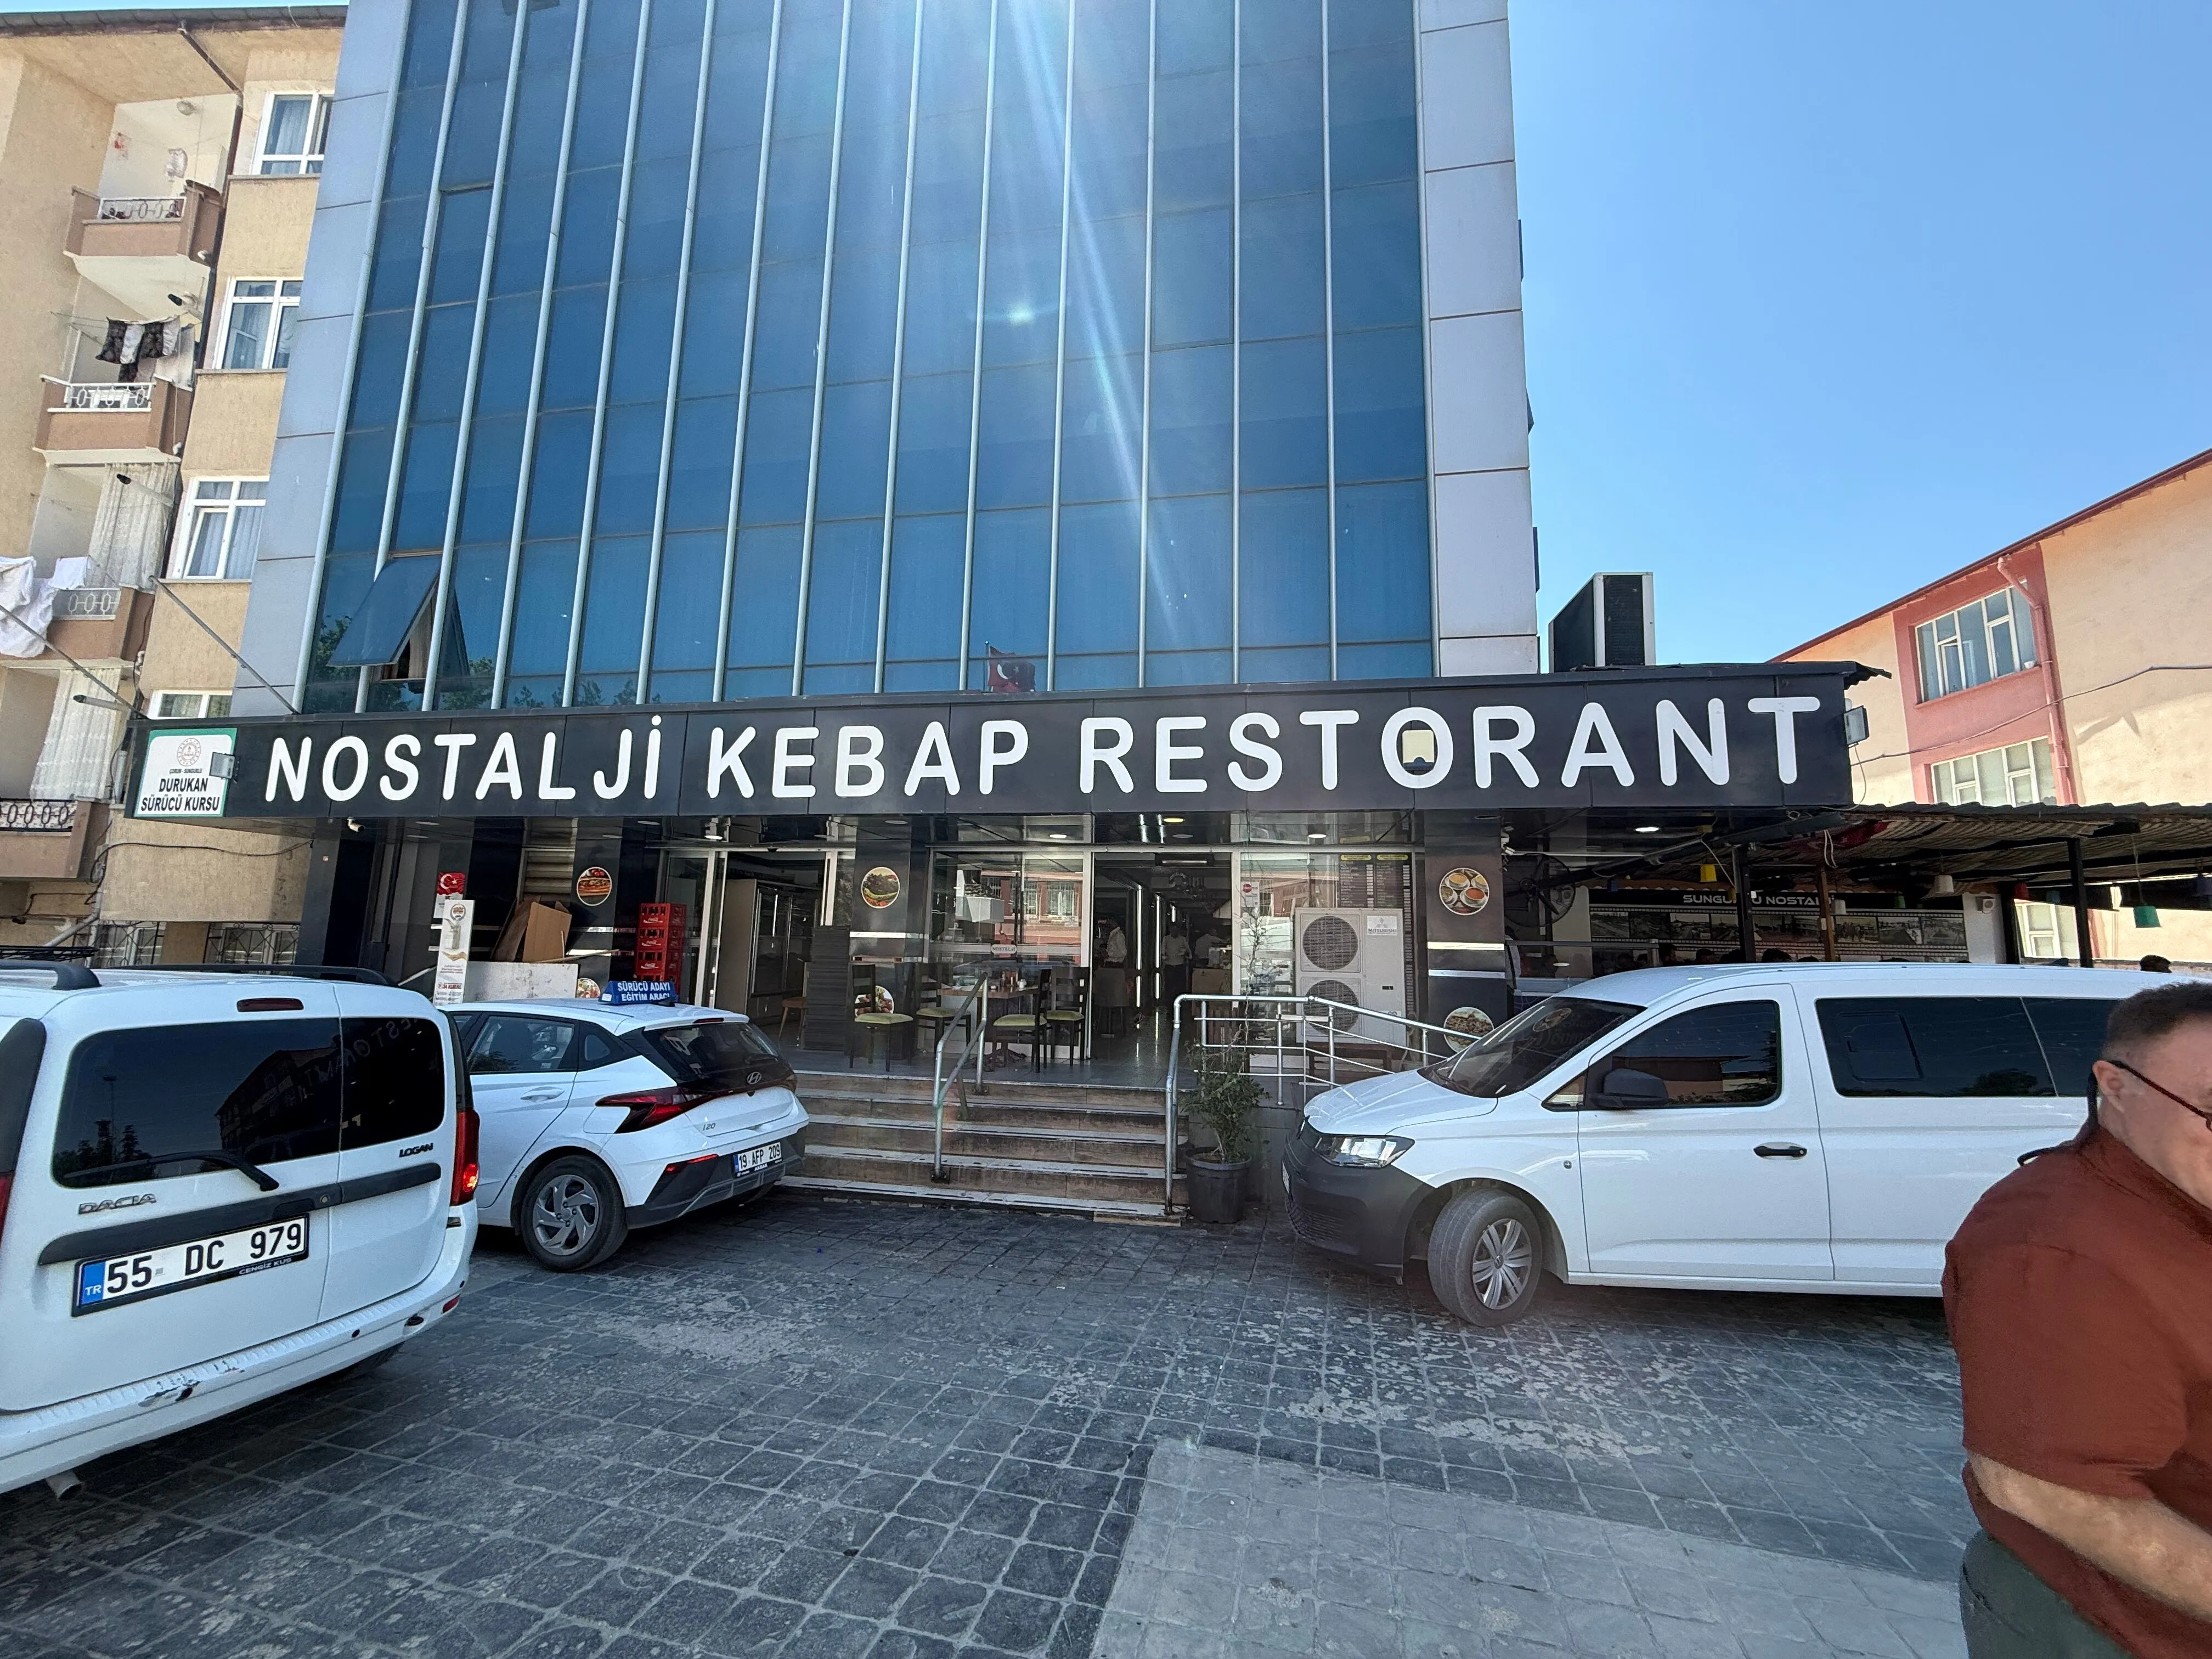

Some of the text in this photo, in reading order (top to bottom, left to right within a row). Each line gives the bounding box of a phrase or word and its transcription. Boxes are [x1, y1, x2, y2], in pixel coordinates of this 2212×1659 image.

[265, 696, 1820, 802] NOSTALJİ KEBAP RESTORANT
[159, 778, 208, 792] DURUKAN
[141, 794, 220, 811] SÜRÜCÜ KURSU
[1683, 894, 1762, 904] SUNGUU
[617, 981, 670, 991] SÜRÜCÜ ADAYI
[621, 991, 648, 1001] EĞİTİM
[399, 1142, 433, 1157] LOGAN
[740, 1144, 780, 1169] 19 AFP 209
[78, 1193, 157, 1215] DACIA
[84, 1223, 302, 1295] TR 55 DC 979
